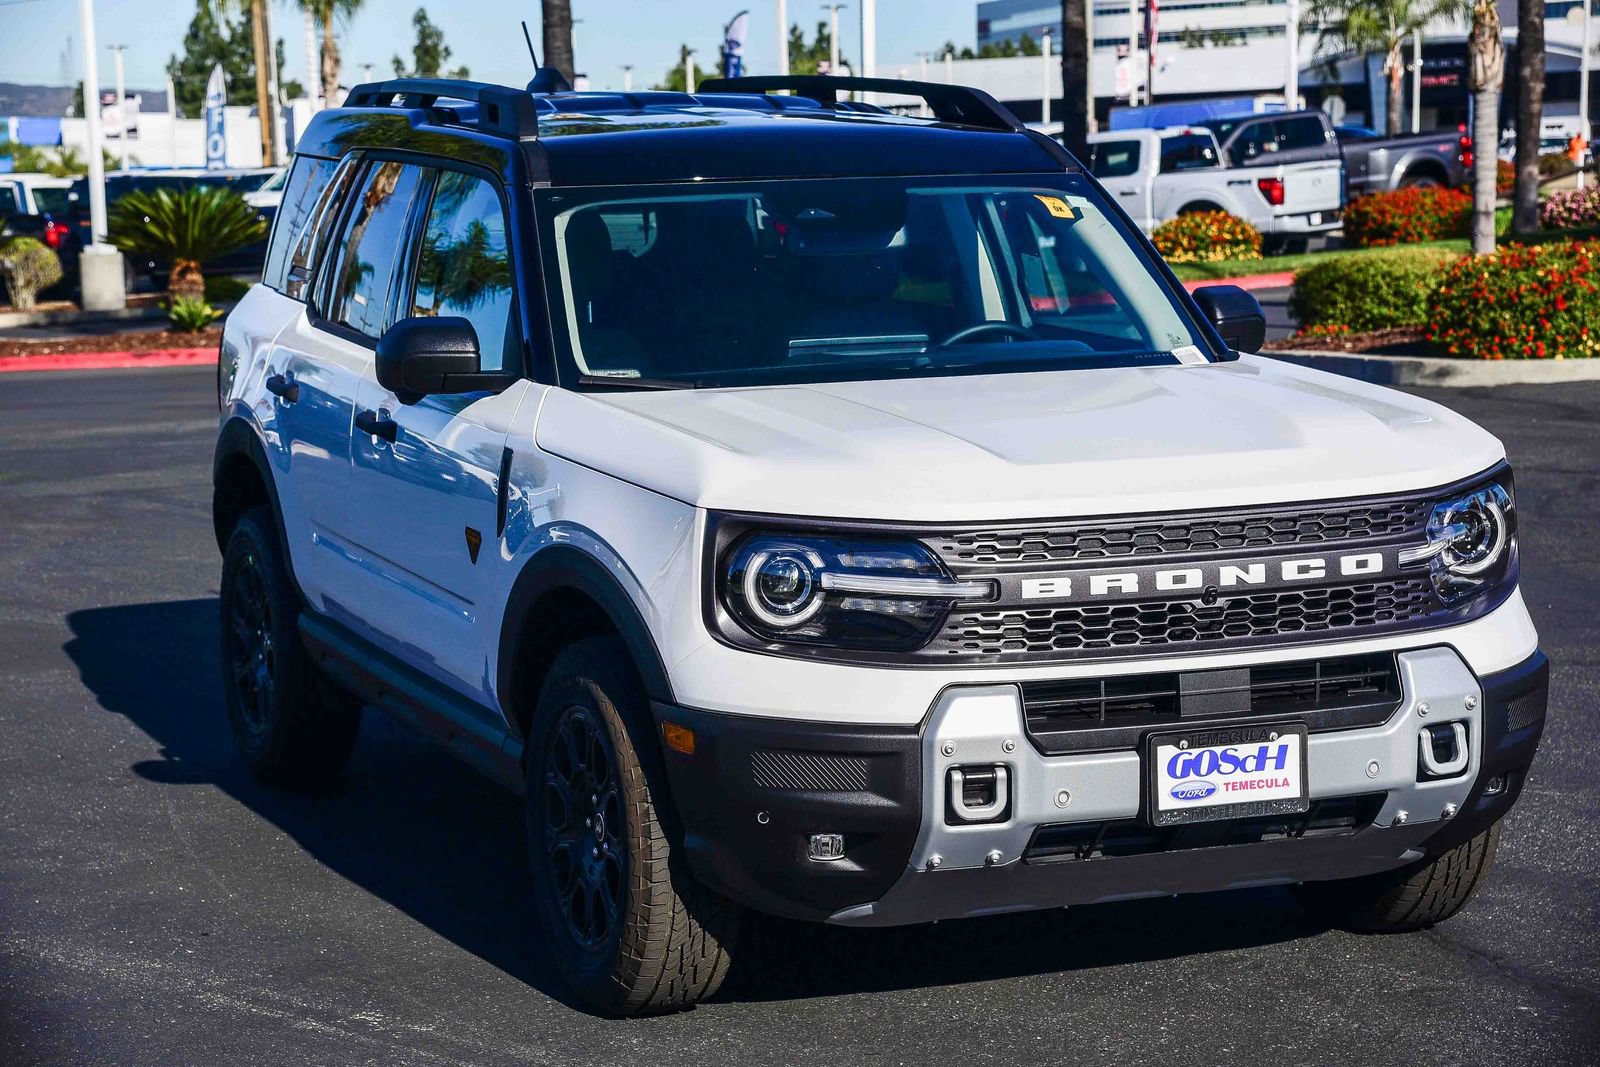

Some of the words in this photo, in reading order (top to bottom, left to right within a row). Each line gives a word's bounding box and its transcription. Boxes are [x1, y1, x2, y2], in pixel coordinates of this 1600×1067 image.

[1021, 552, 1383, 599] BRONCO
[1189, 729, 1268, 748] TEMECULA
[1178, 786, 1208, 798] Ford
[1223, 777, 1290, 791] TEMECULA
